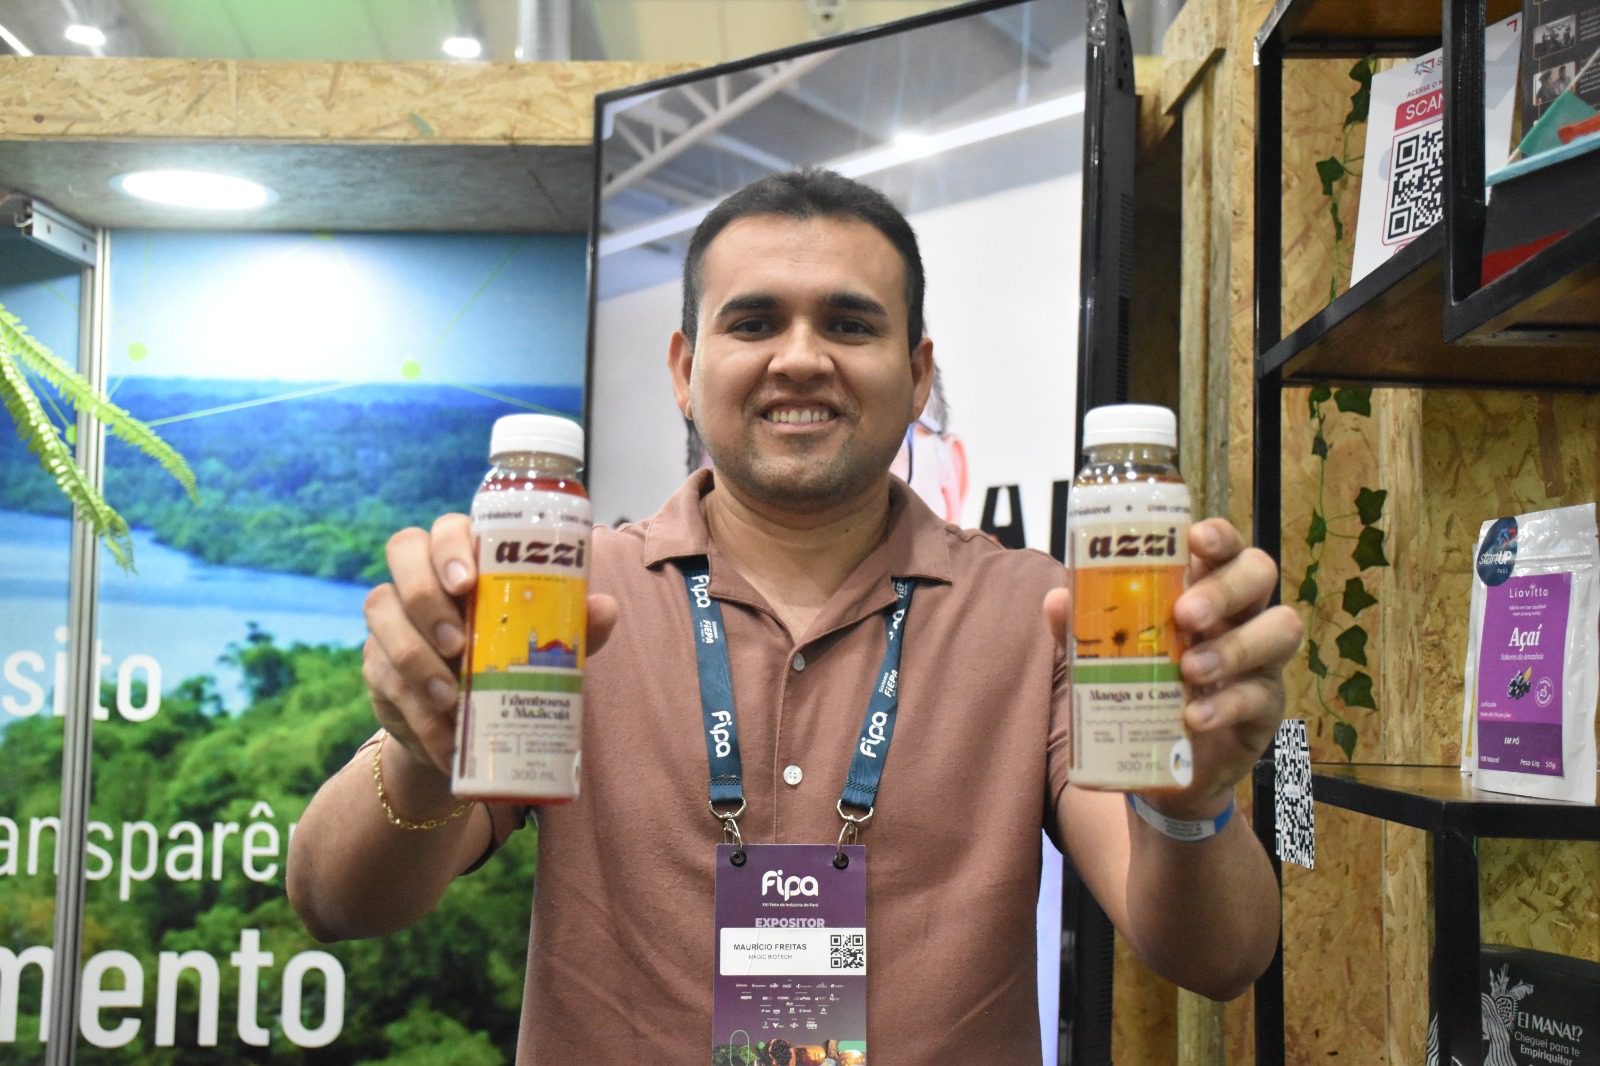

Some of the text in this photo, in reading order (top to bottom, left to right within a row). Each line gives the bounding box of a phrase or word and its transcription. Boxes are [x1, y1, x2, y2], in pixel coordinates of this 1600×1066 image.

[495, 539, 585, 569] azzi
[1089, 527, 1176, 559] azzi
[1508, 623, 1543, 651] Açaí
[709, 710, 733, 758] Fipa
[859, 711, 888, 758] Fipa
[0, 801, 300, 901] ansparê
[762, 869, 819, 901] Fipa
[755, 917, 826, 928] EXPOSITOR
[733, 942, 807, 951] MAURÍCIO FREITAS
[1514, 1030, 1580, 1057] Cheguei para te
